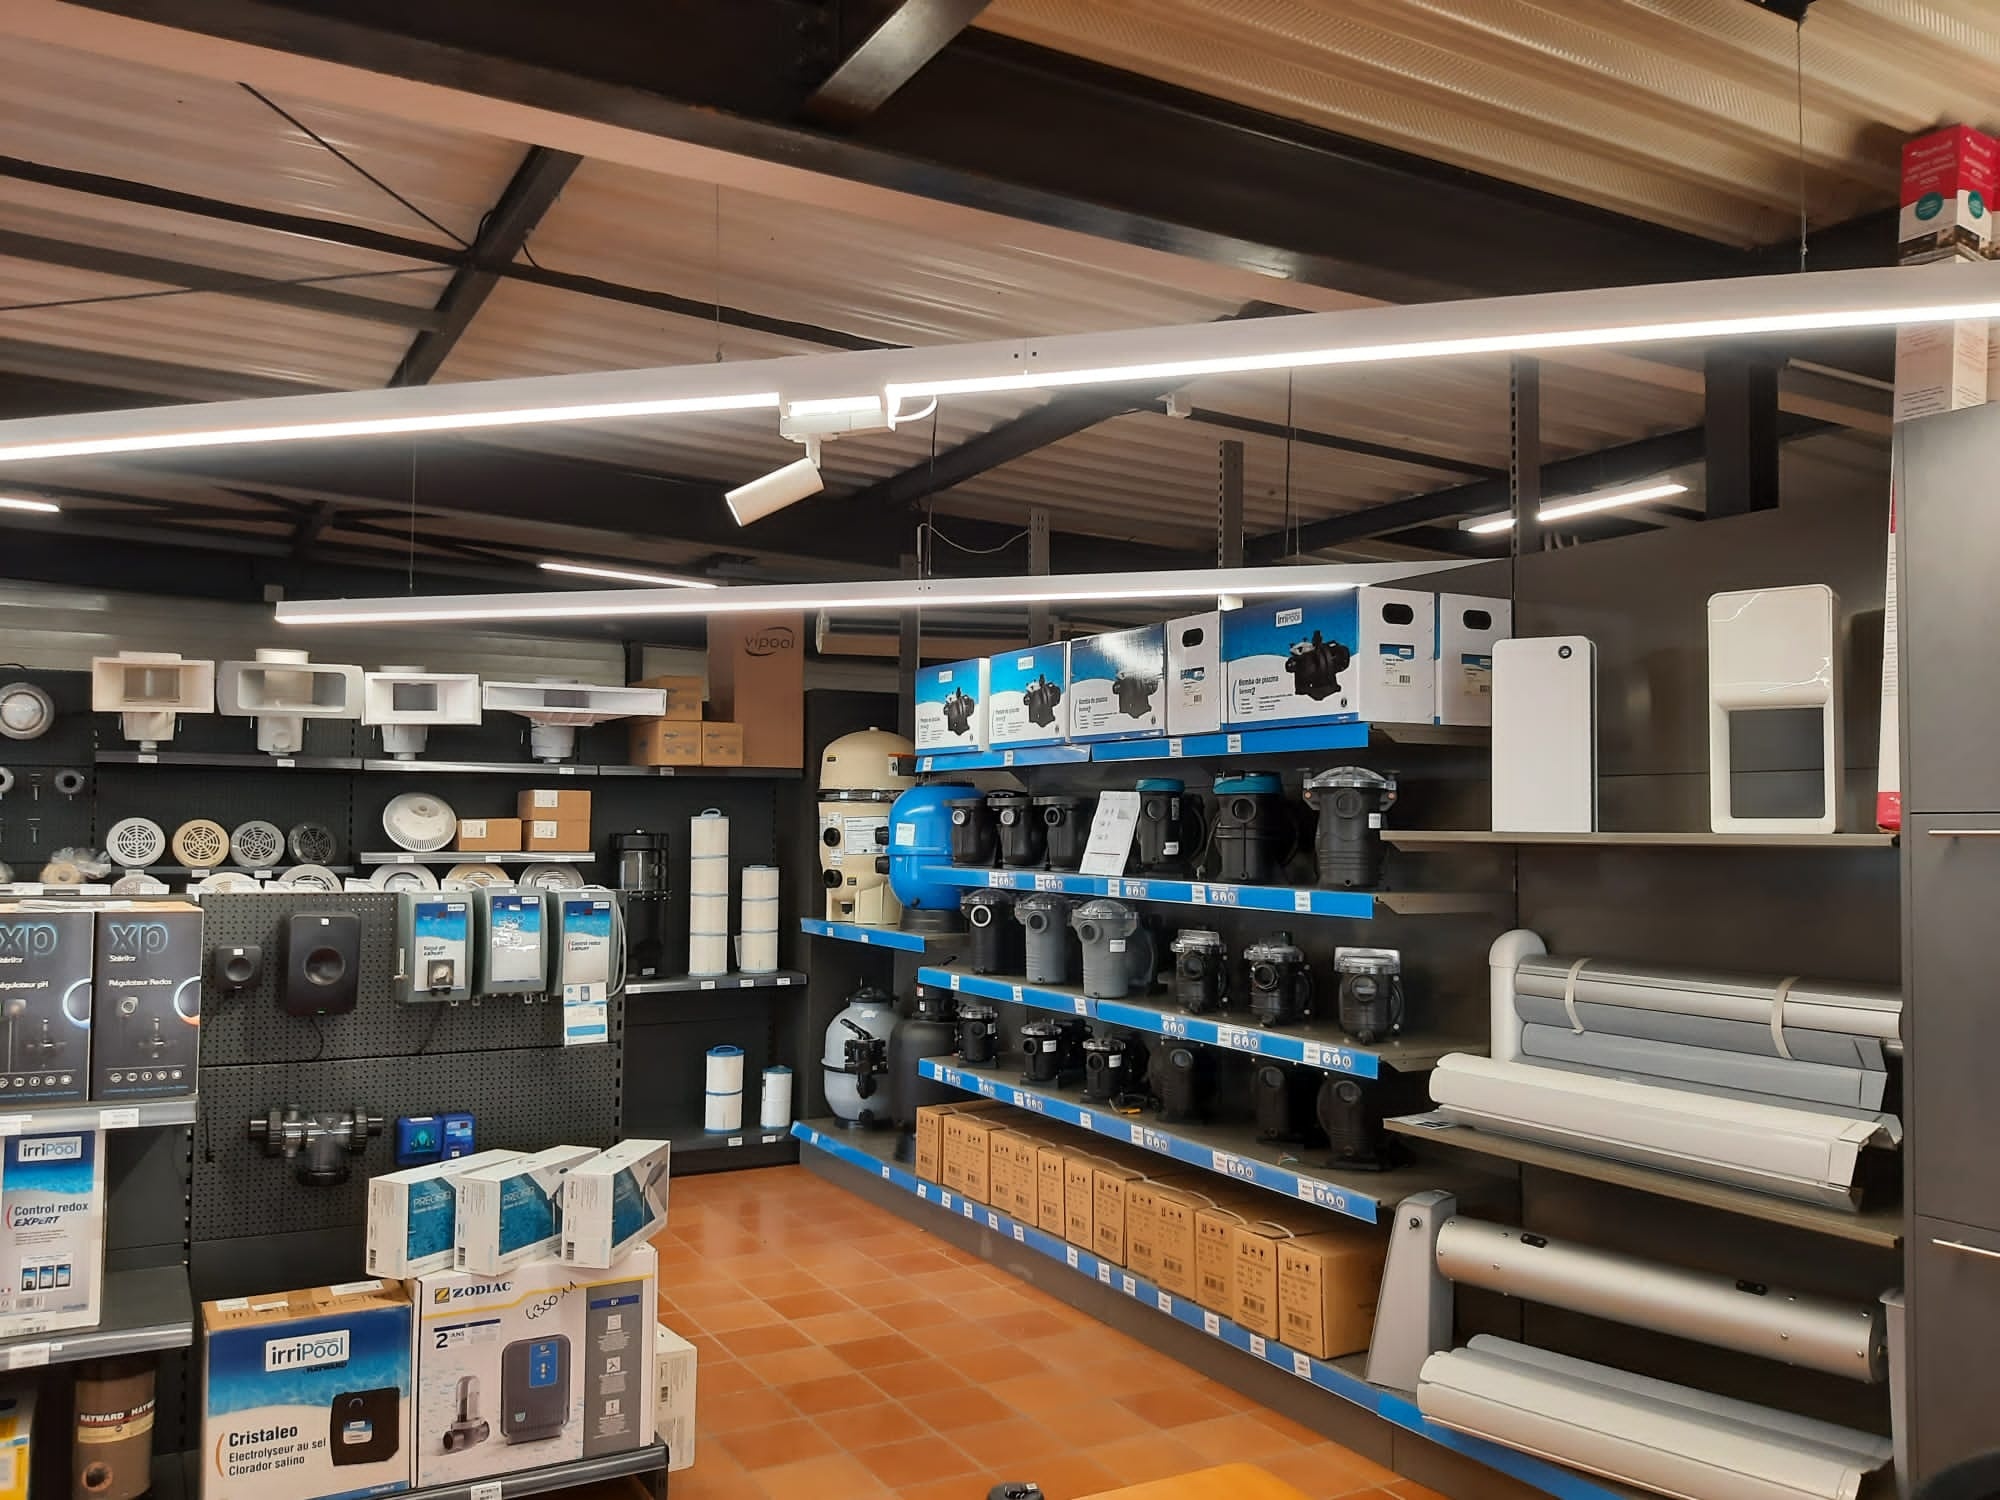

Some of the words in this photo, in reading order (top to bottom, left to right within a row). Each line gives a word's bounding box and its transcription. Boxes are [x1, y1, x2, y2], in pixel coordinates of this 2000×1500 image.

[23, 1141, 77, 1158] irriPool
[14, 1204, 55, 1216] Control
[58, 1202, 88, 1213] redox
[13, 1216, 60, 1227] EXPERT
[452, 1282, 512, 1298] ZODIAC
[436, 1333, 449, 1349] 2
[271, 1337, 344, 1365] irriPool
[228, 1426, 298, 1447] Cristaleo
[228, 1443, 295, 1463] Electrolyseur
[297, 1442, 310, 1453] au
[312, 1437, 327, 1449] sel
[228, 1461, 272, 1477] Clorador
[275, 1455, 305, 1468] salino
